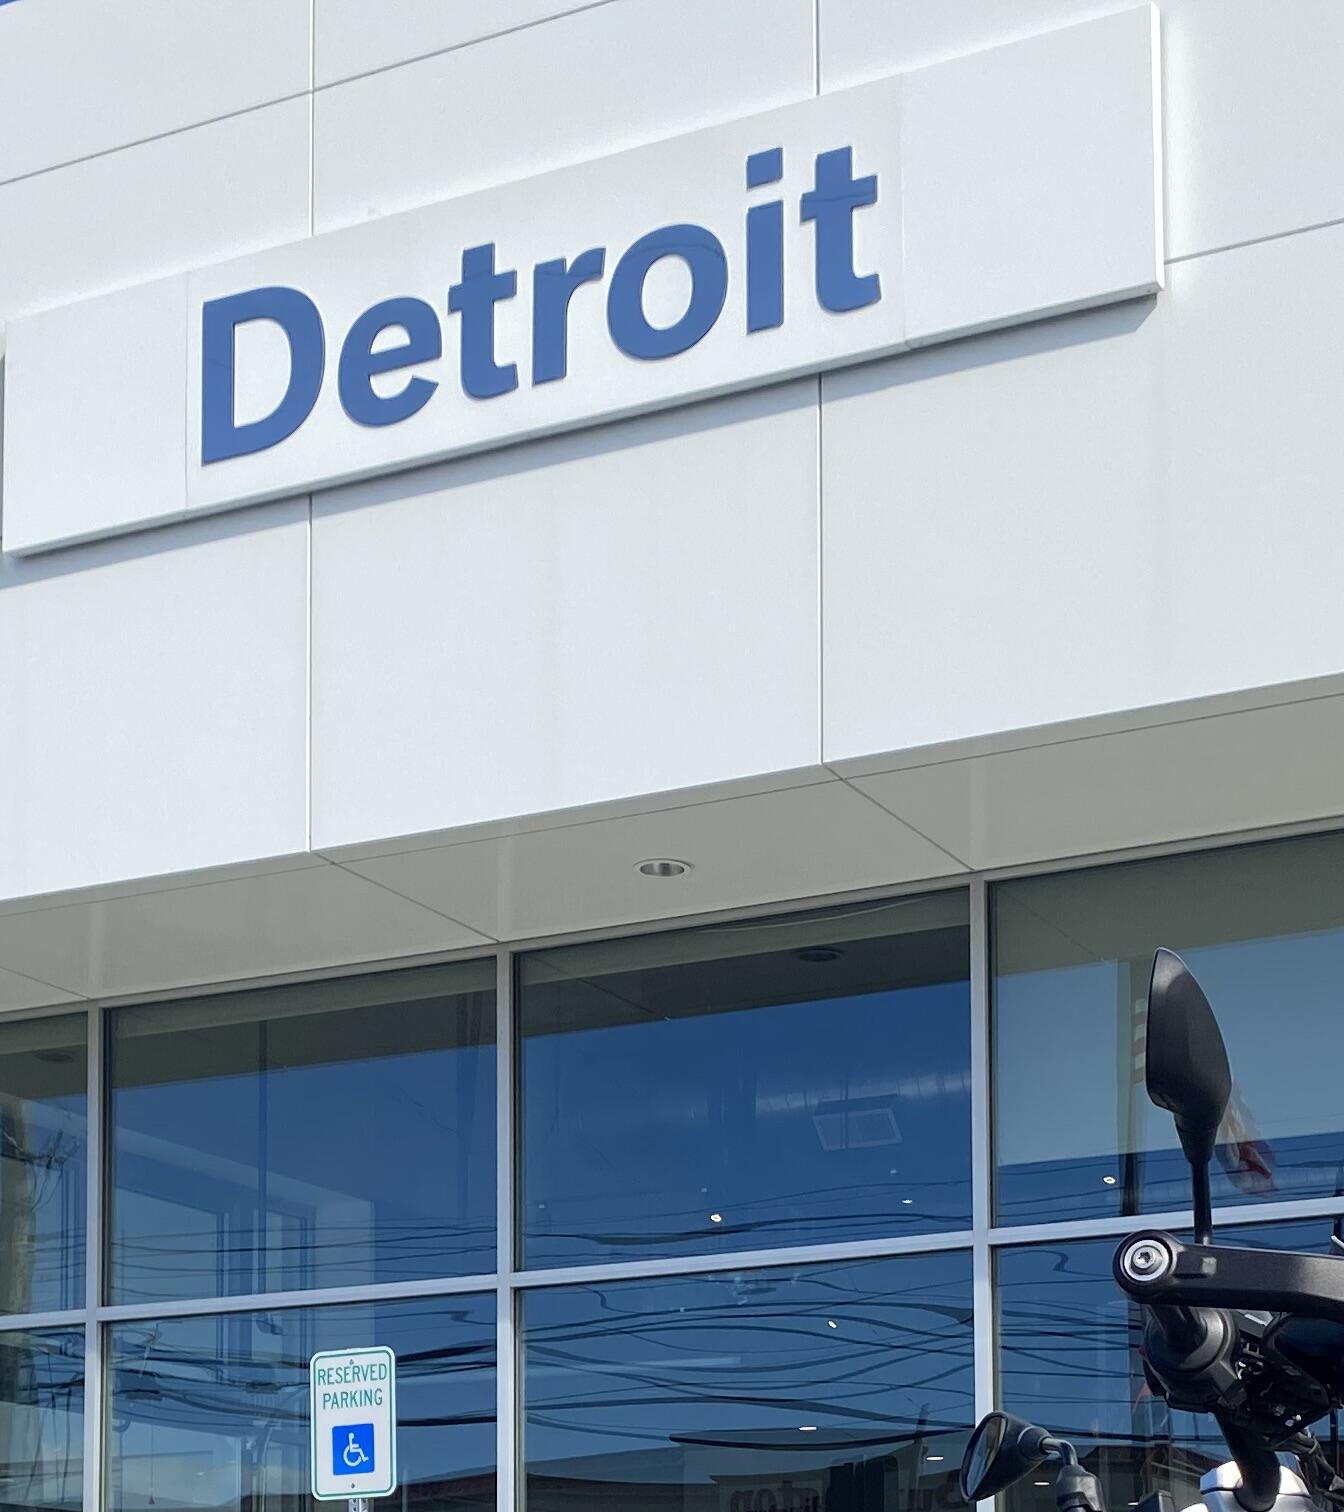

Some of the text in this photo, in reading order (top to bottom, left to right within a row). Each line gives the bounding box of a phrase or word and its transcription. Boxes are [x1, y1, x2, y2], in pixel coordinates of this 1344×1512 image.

[201, 146, 882, 466] Detroit
[317, 1363, 387, 1386] RESERVED
[322, 1388, 383, 1410] PARKING
